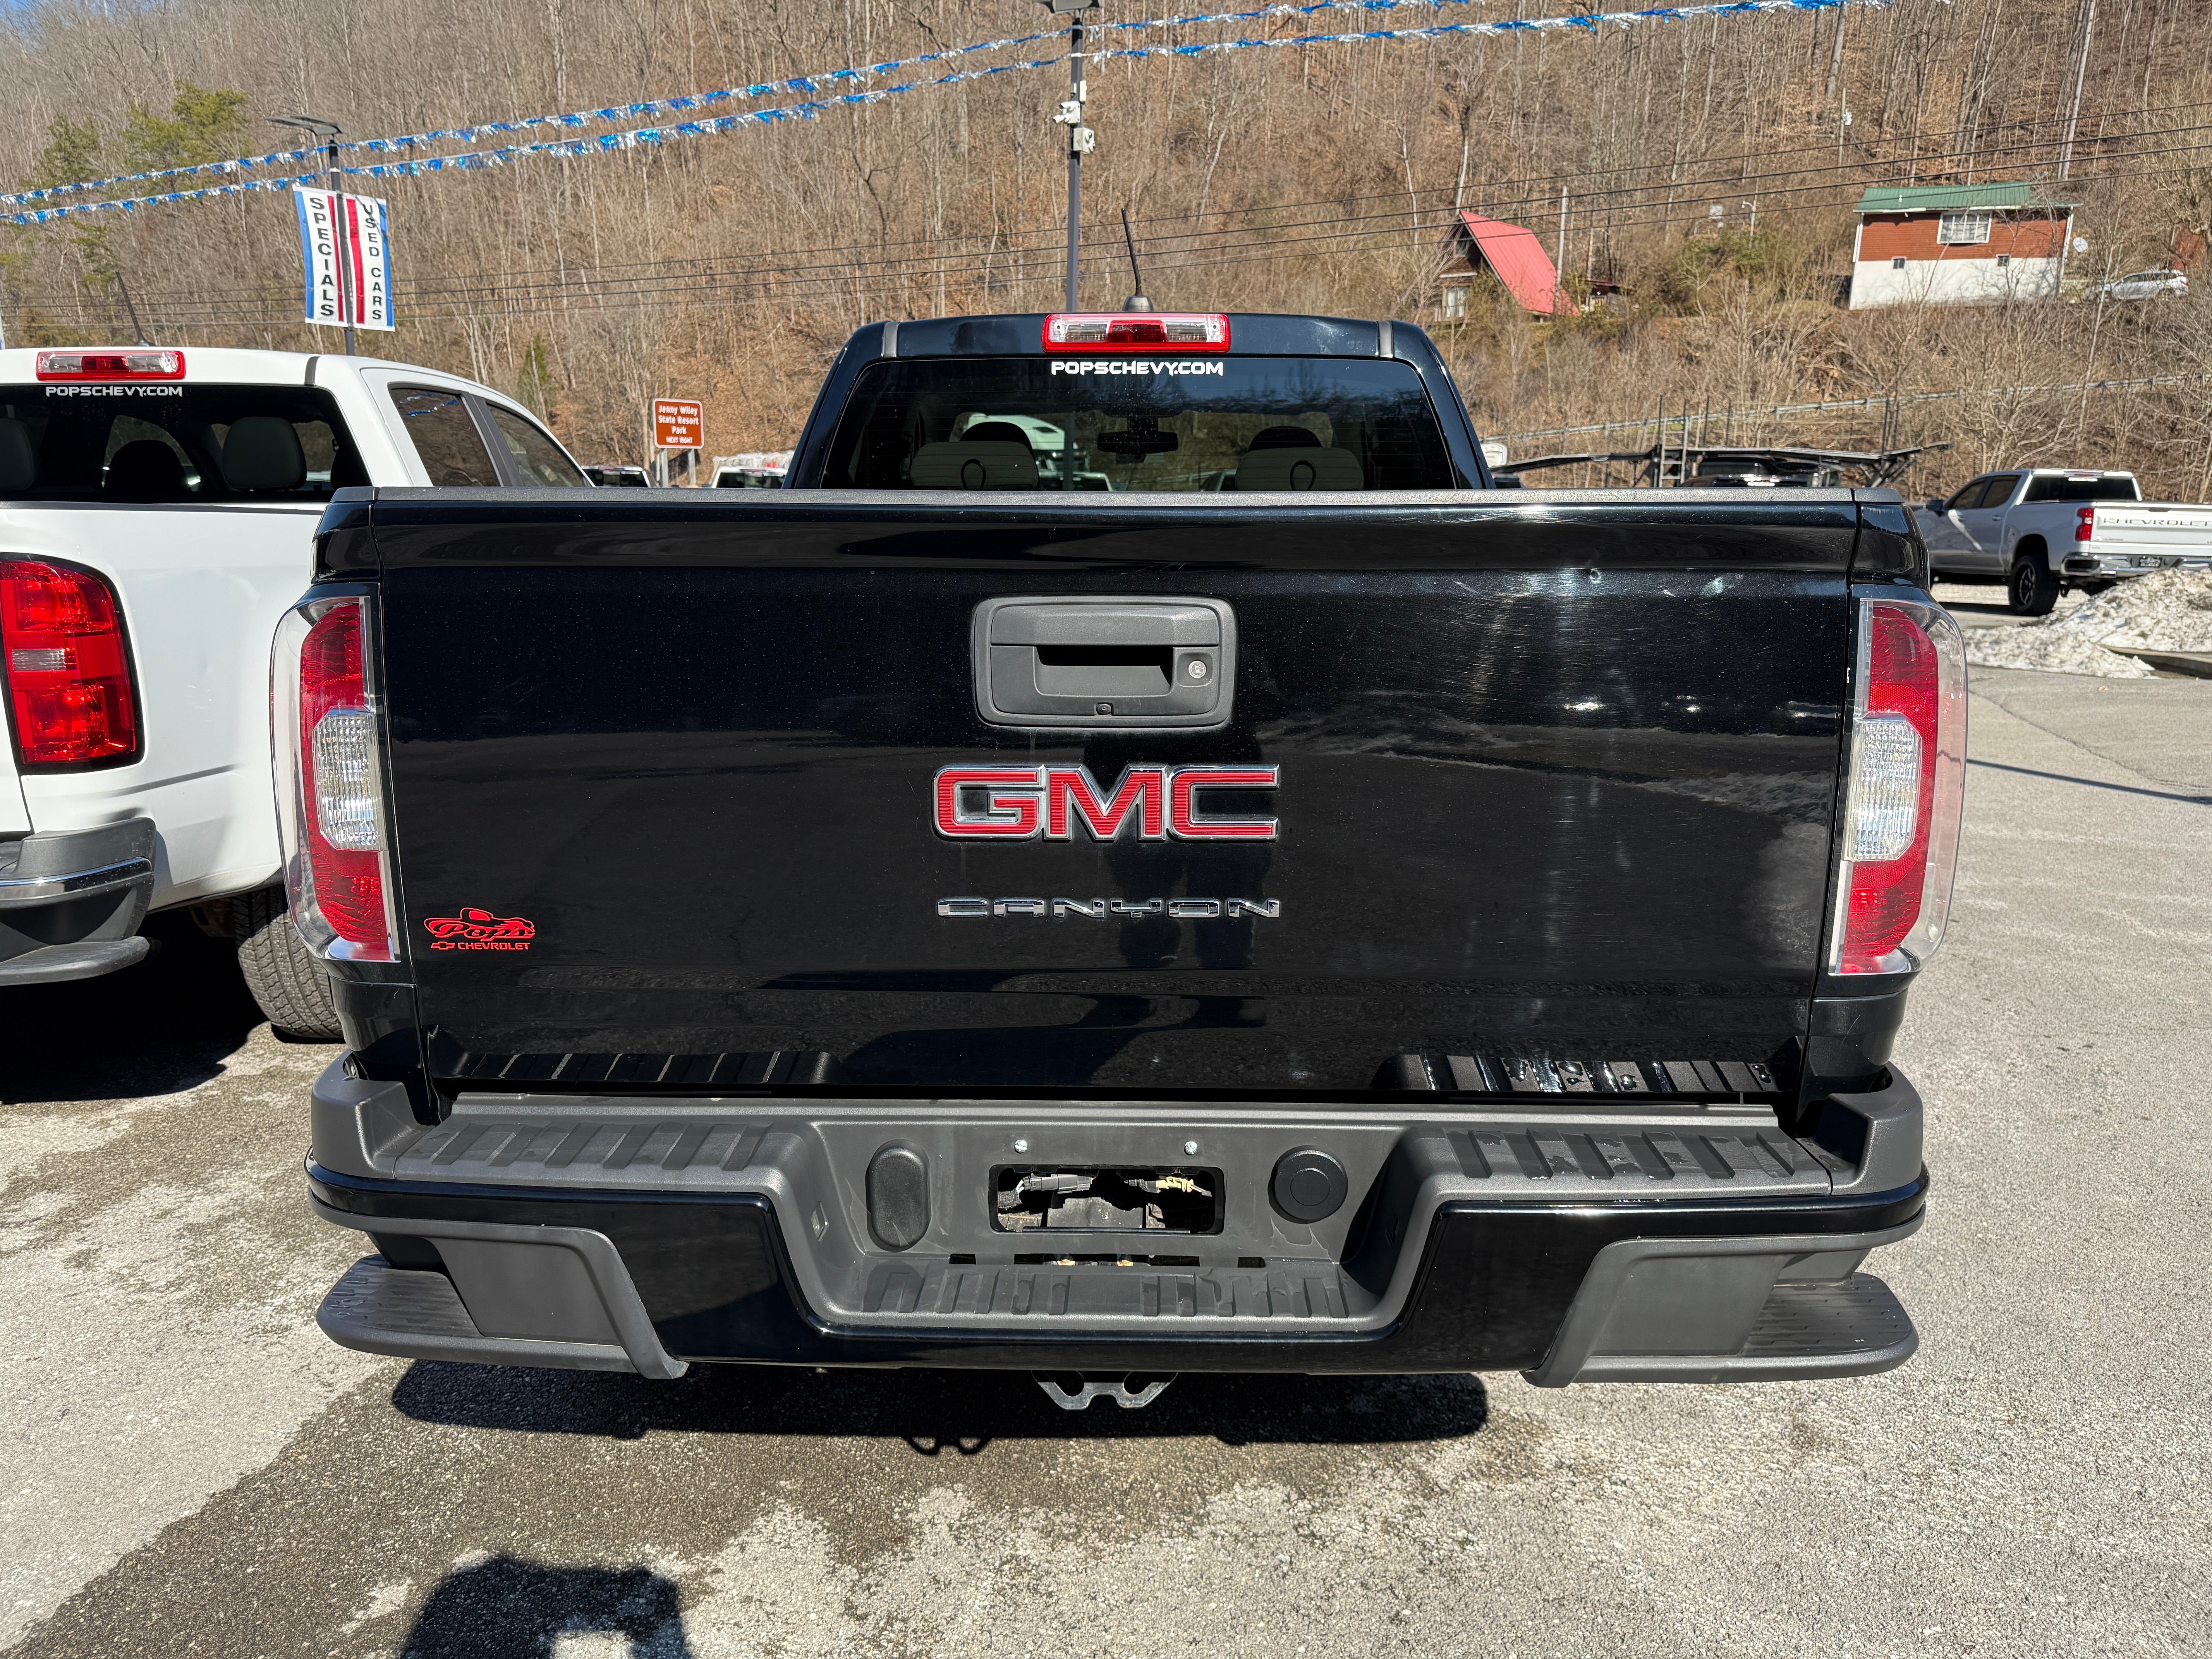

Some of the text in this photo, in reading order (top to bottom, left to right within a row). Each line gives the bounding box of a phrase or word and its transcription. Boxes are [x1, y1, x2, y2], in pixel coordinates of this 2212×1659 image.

[309, 197, 335, 316] SPECIALS
[362, 204, 382, 320] USED CARS
[1051, 360, 1224, 376] POPSCHEVY.COM
[45, 385, 183, 397] POPSCHEVY.COM
[658, 405, 698, 417] Jenny Wiley
[658, 415, 699, 425] State Resort
[671, 425, 687, 434] Park
[2103, 517, 2212, 526] CHEVROLET
[933, 764, 1280, 842] GMC
[937, 898, 1280, 918] CANYON
[458, 942, 530, 950] CHEVROLET
